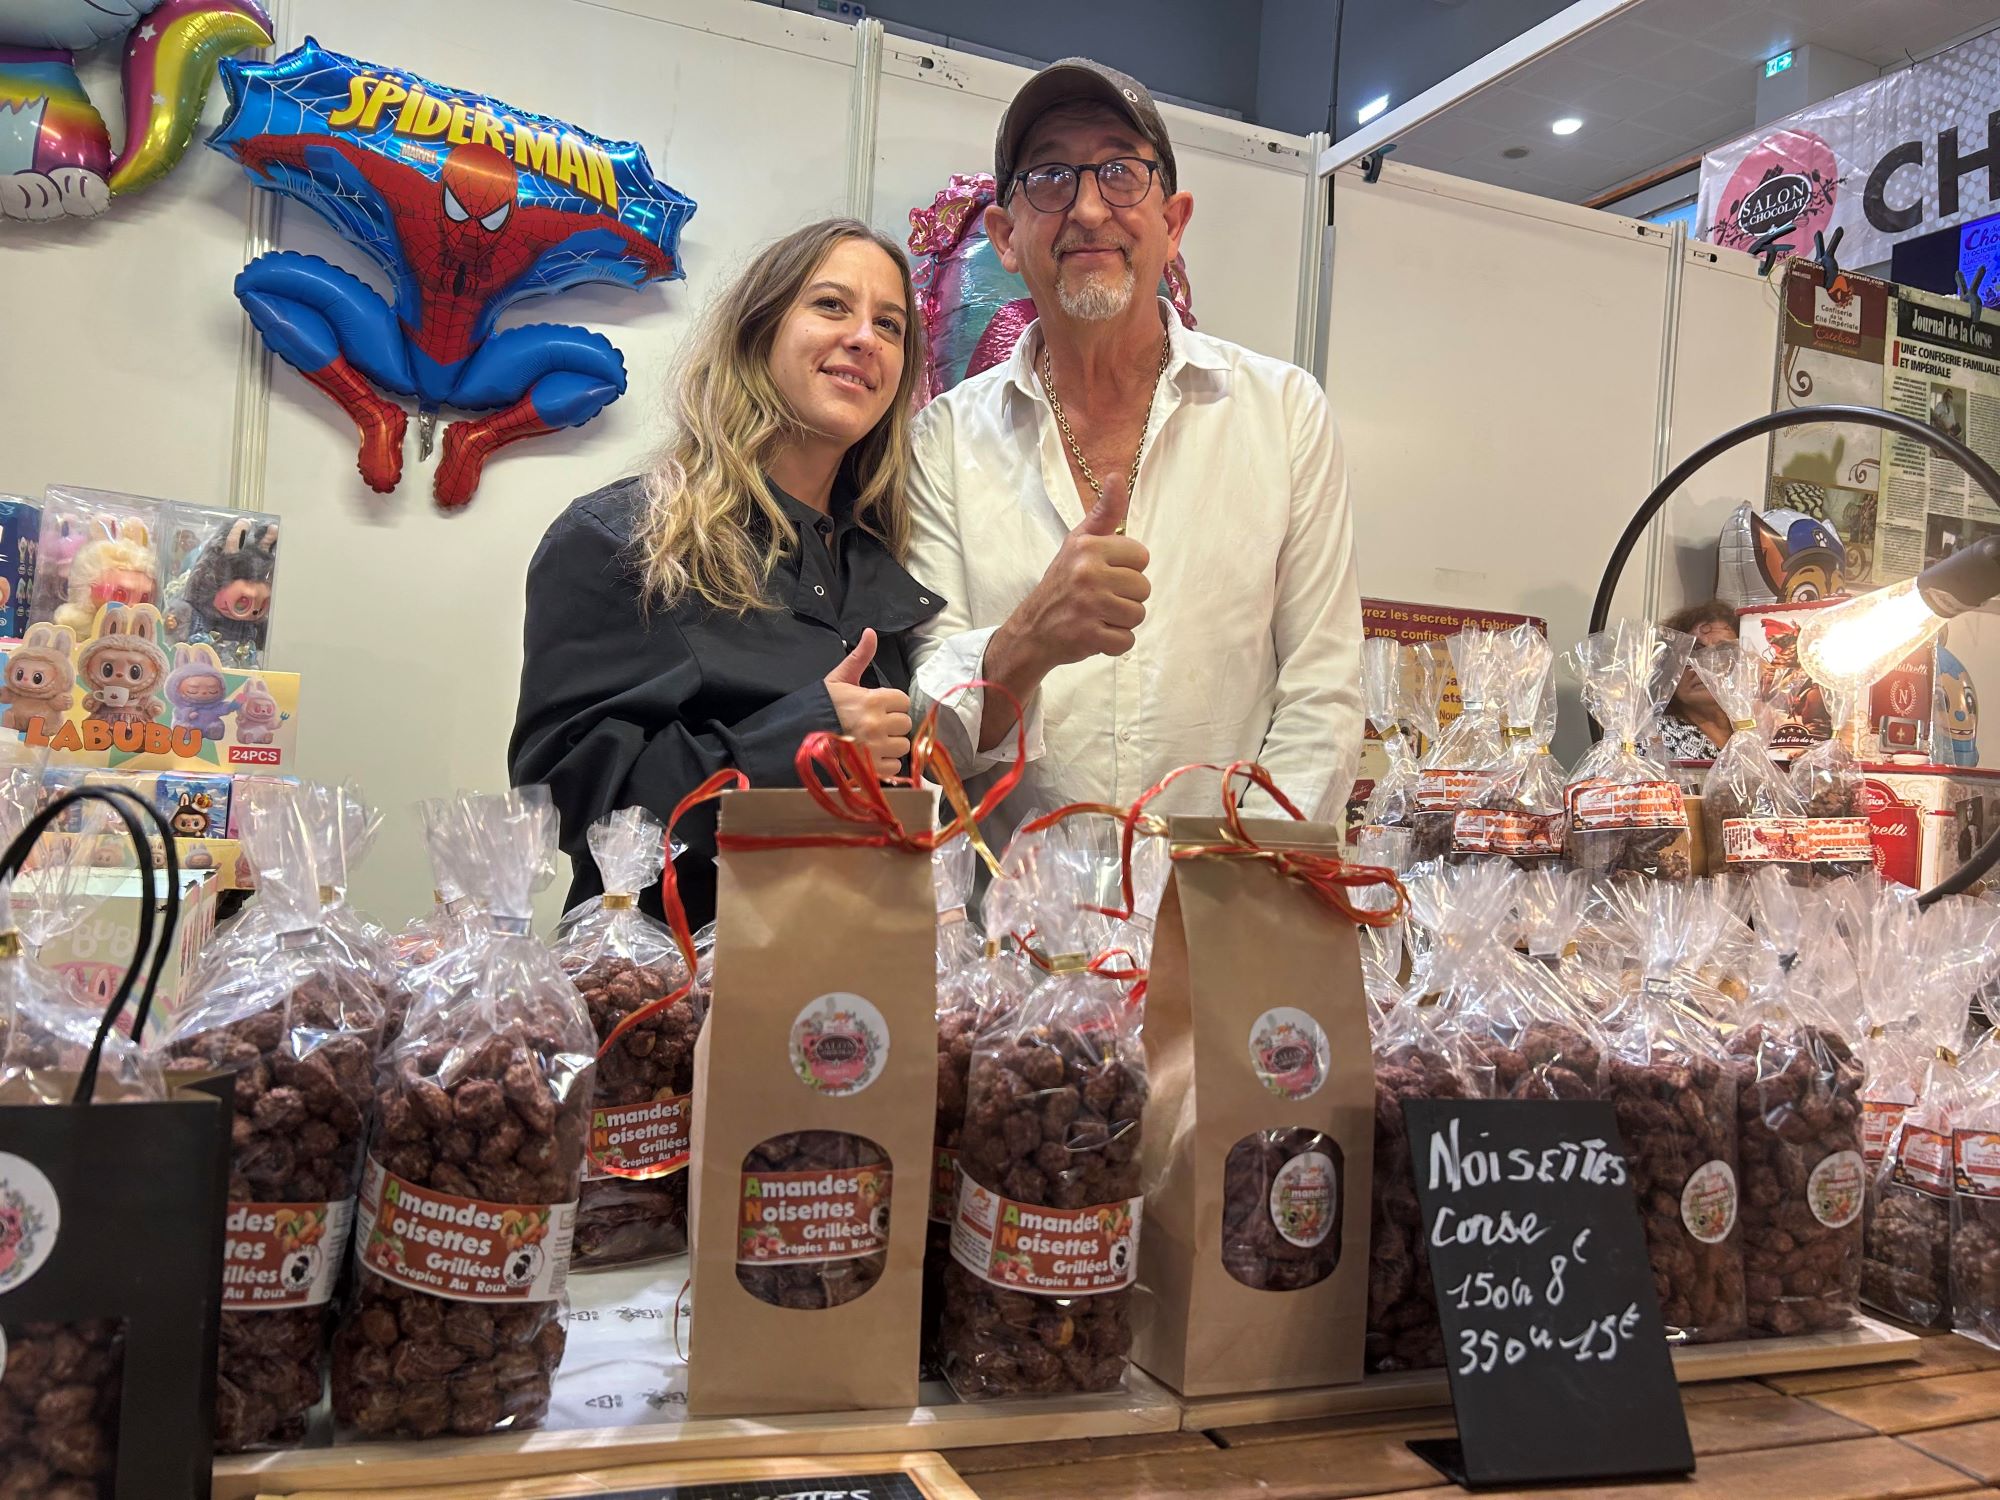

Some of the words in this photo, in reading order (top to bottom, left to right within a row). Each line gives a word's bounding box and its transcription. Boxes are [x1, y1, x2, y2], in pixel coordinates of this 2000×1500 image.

[329, 75, 618, 211] SPIDER-MAN
[400, 142, 437, 164] MARVEL
[1742, 181, 1806, 218] SALON
[1749, 197, 1806, 225] CHOCOLAT
[1912, 308, 1946, 337] Journal
[1948, 318, 1958, 340] de
[1960, 321, 1968, 343] la
[1970, 324, 1993, 350] Corse
[1900, 357, 1909, 369] ET
[1910, 360, 1951, 379] IMPÉRIALE
[1901, 342, 1917, 356] UNE
[1918, 347, 1961, 367] CONFISERIE
[1963, 358, 2000, 376] FAMILIALE
[1390, 609, 1409, 621] les
[1412, 613, 1459, 626] secrets
[1463, 617, 1477, 627] de
[1375, 627, 1397, 638] nos
[1899, 688, 1909, 705] N
[24, 716, 202, 758] LABUBU
[231, 748, 278, 763] 24PCS
[593, 1103, 680, 1129] Amandes
[594, 1121, 678, 1148] Noisettes
[639, 1137, 688, 1154] Grillées
[620, 1156, 654, 1169] Crépies
[658, 1151, 671, 1161] Au
[744, 1174, 858, 1198] Amandes
[385, 1179, 503, 1231] Amandes
[745, 1199, 855, 1222] Noisettes
[381, 1204, 493, 1257] Noisettes
[803, 1221, 868, 1240] Grillées
[1002, 1204, 1099, 1234] Amandes
[1431, 1206, 1551, 1247] Corse
[777, 1241, 822, 1255] Crépies
[828, 1241, 845, 1252] Au
[851, 1237, 877, 1250] Roux
[1001, 1225, 1099, 1256] Noisettes
[395, 1262, 443, 1285] Crépies
[449, 1278, 469, 1291] Au
[475, 1282, 508, 1293] Roux
[426, 1252, 501, 1279] Grillées
[1052, 1258, 1108, 1275] Grillées
[1026, 1273, 1069, 1287] Crépies
[1073, 1275, 1088, 1287] Au
[1093, 1274, 1116, 1286] Roux
[223, 1287, 246, 1300] Au
[252, 1286, 287, 1299] Roux
